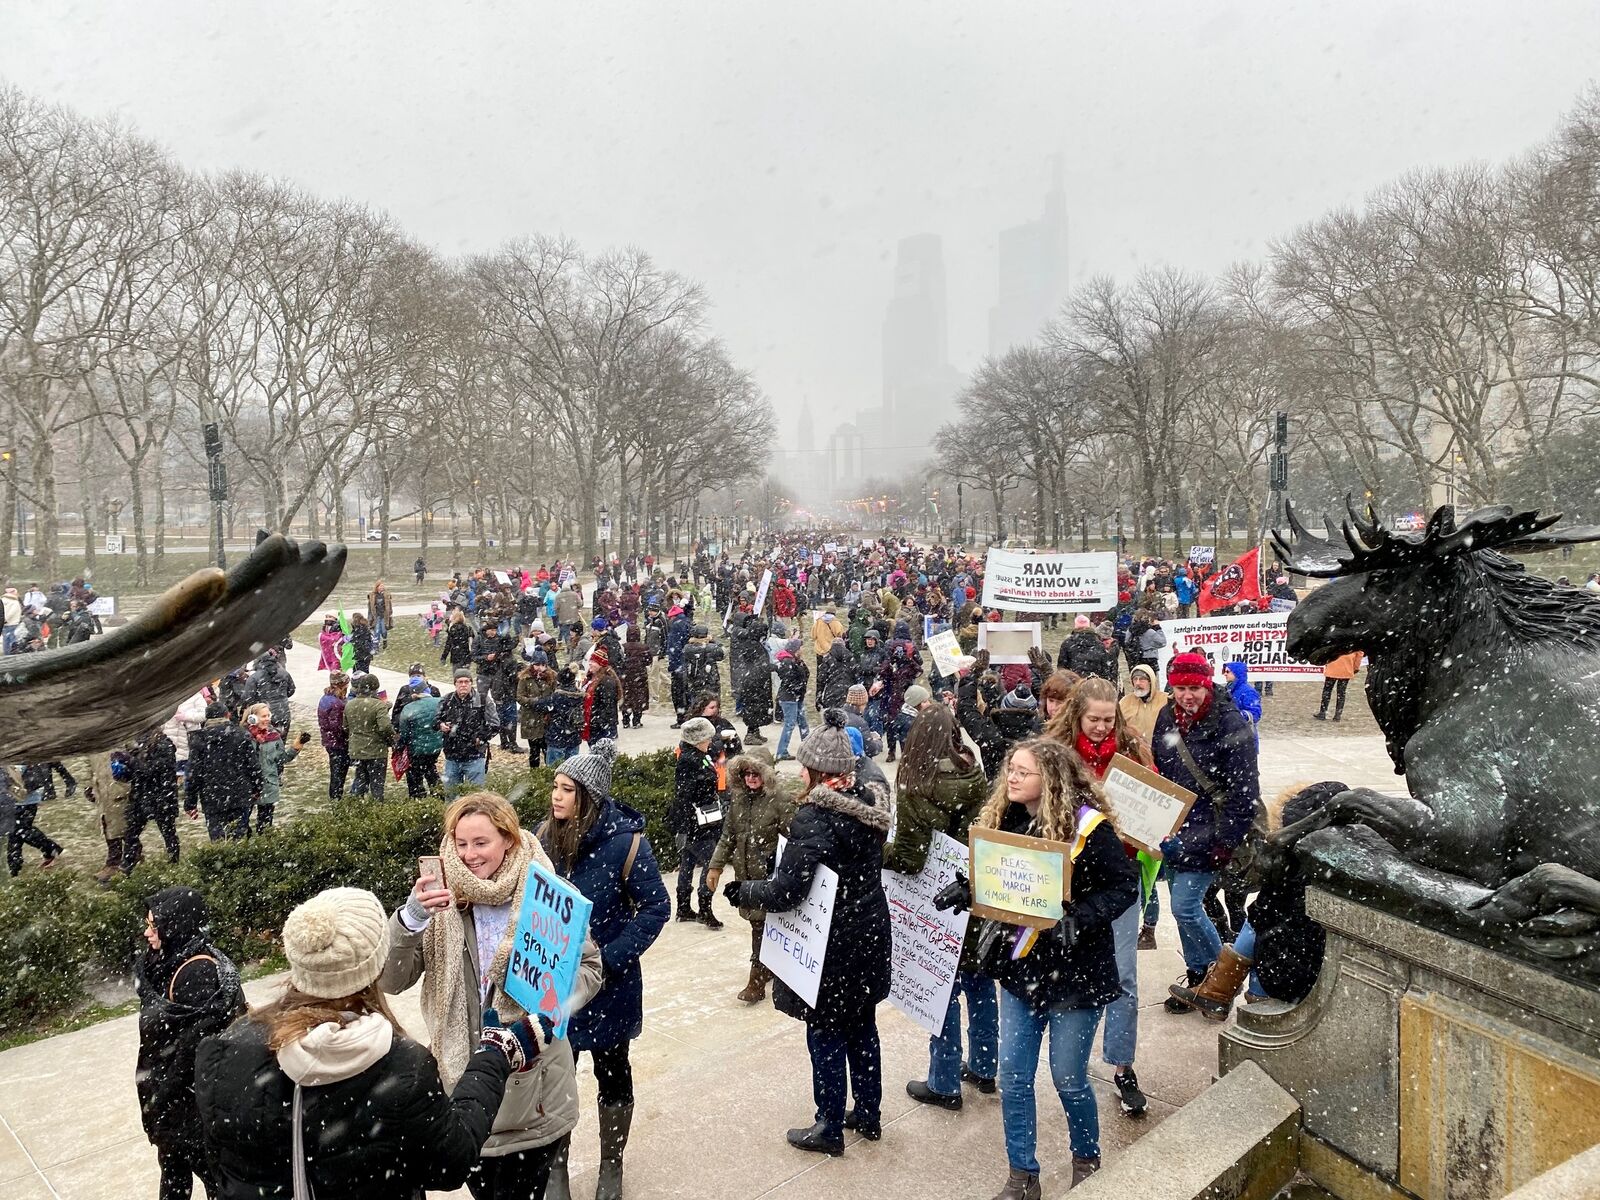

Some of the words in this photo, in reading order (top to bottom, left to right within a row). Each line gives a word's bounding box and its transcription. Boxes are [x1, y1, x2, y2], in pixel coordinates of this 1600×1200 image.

[1142, 787, 1171, 810] LIVES
[1000, 856, 1032, 871] PLEASE
[1002, 880, 1031, 893] MARCH
[1010, 870, 1036, 883] MAKE
[1037, 874, 1051, 885] ME
[533, 871, 574, 924] THIS
[985, 889, 991, 899] 4
[991, 890, 1011, 904] MORE
[1021, 895, 1048, 908] YEARS
[778, 916, 809, 941] madman
[815, 922, 822, 934] a
[765, 922, 791, 953] VOTE
[792, 941, 820, 975] BLUE
[511, 950, 542, 991] BACK
[924, 985, 938, 999] of
